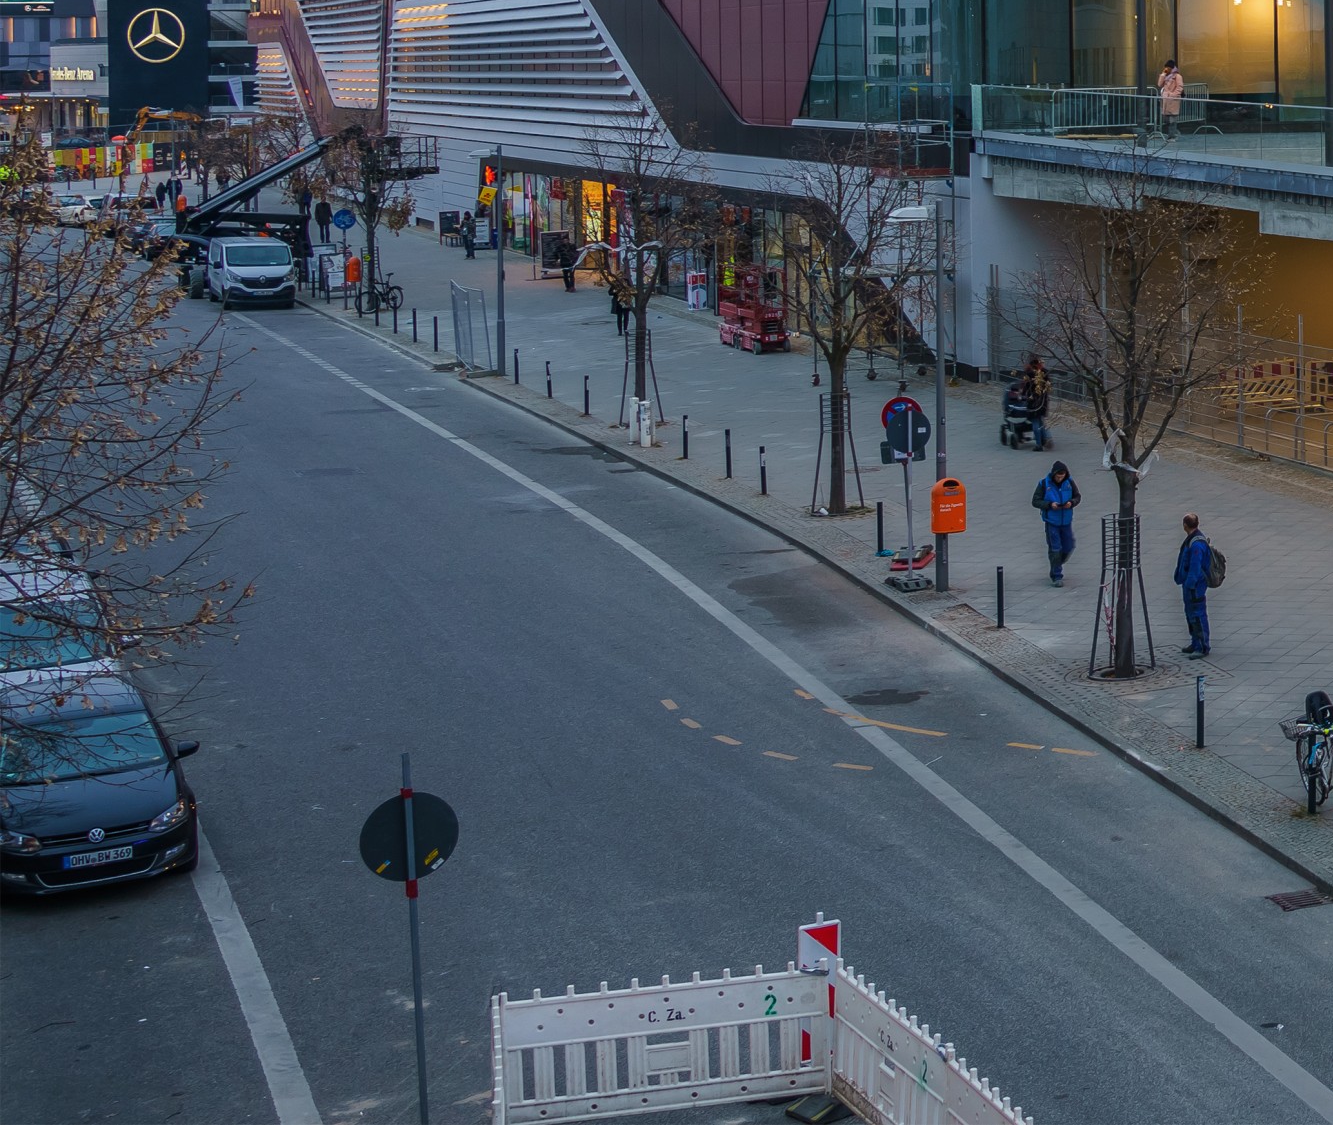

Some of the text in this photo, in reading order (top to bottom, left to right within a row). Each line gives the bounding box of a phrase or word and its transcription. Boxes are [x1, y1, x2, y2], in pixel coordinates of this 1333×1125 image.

[76, 66, 94, 81] Arena
[113, 847, 132, 859] 369
[764, 994, 778, 1016] 2
[648, 1007, 686, 1023] C. Za.
